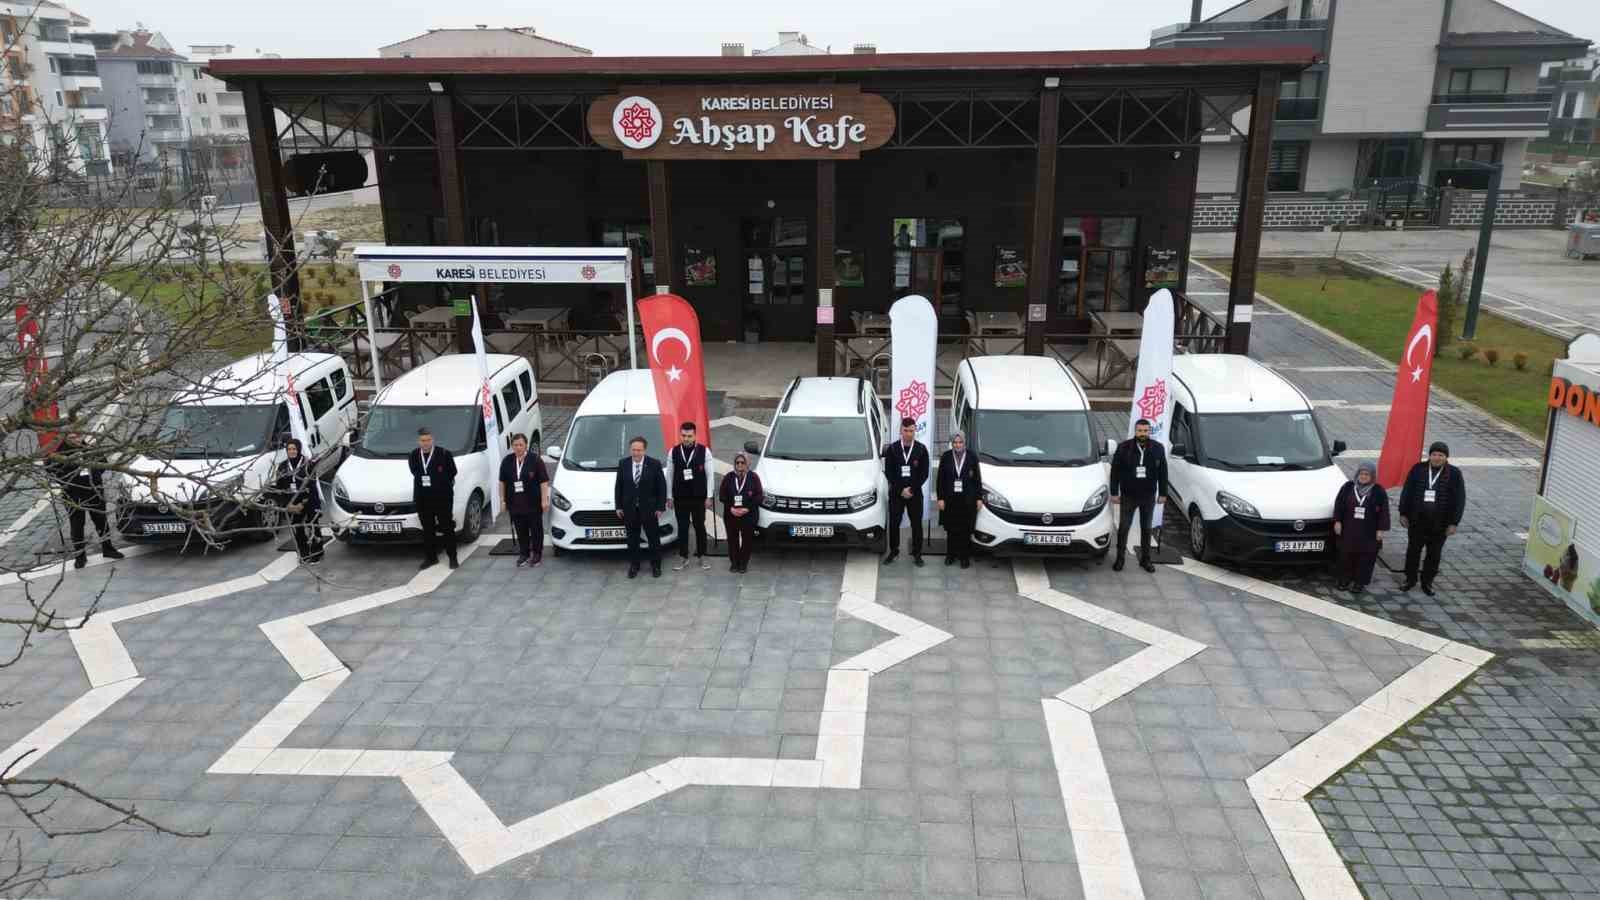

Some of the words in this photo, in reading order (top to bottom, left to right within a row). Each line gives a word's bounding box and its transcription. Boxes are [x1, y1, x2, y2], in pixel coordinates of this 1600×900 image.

[701, 95, 750, 110] KARESİ
[752, 93, 834, 110] BELEDİYESİ
[669, 116, 776, 151] Ahşap
[783, 114, 867, 151] Kafe
[479, 265, 546, 280] BELEDİYESİ
